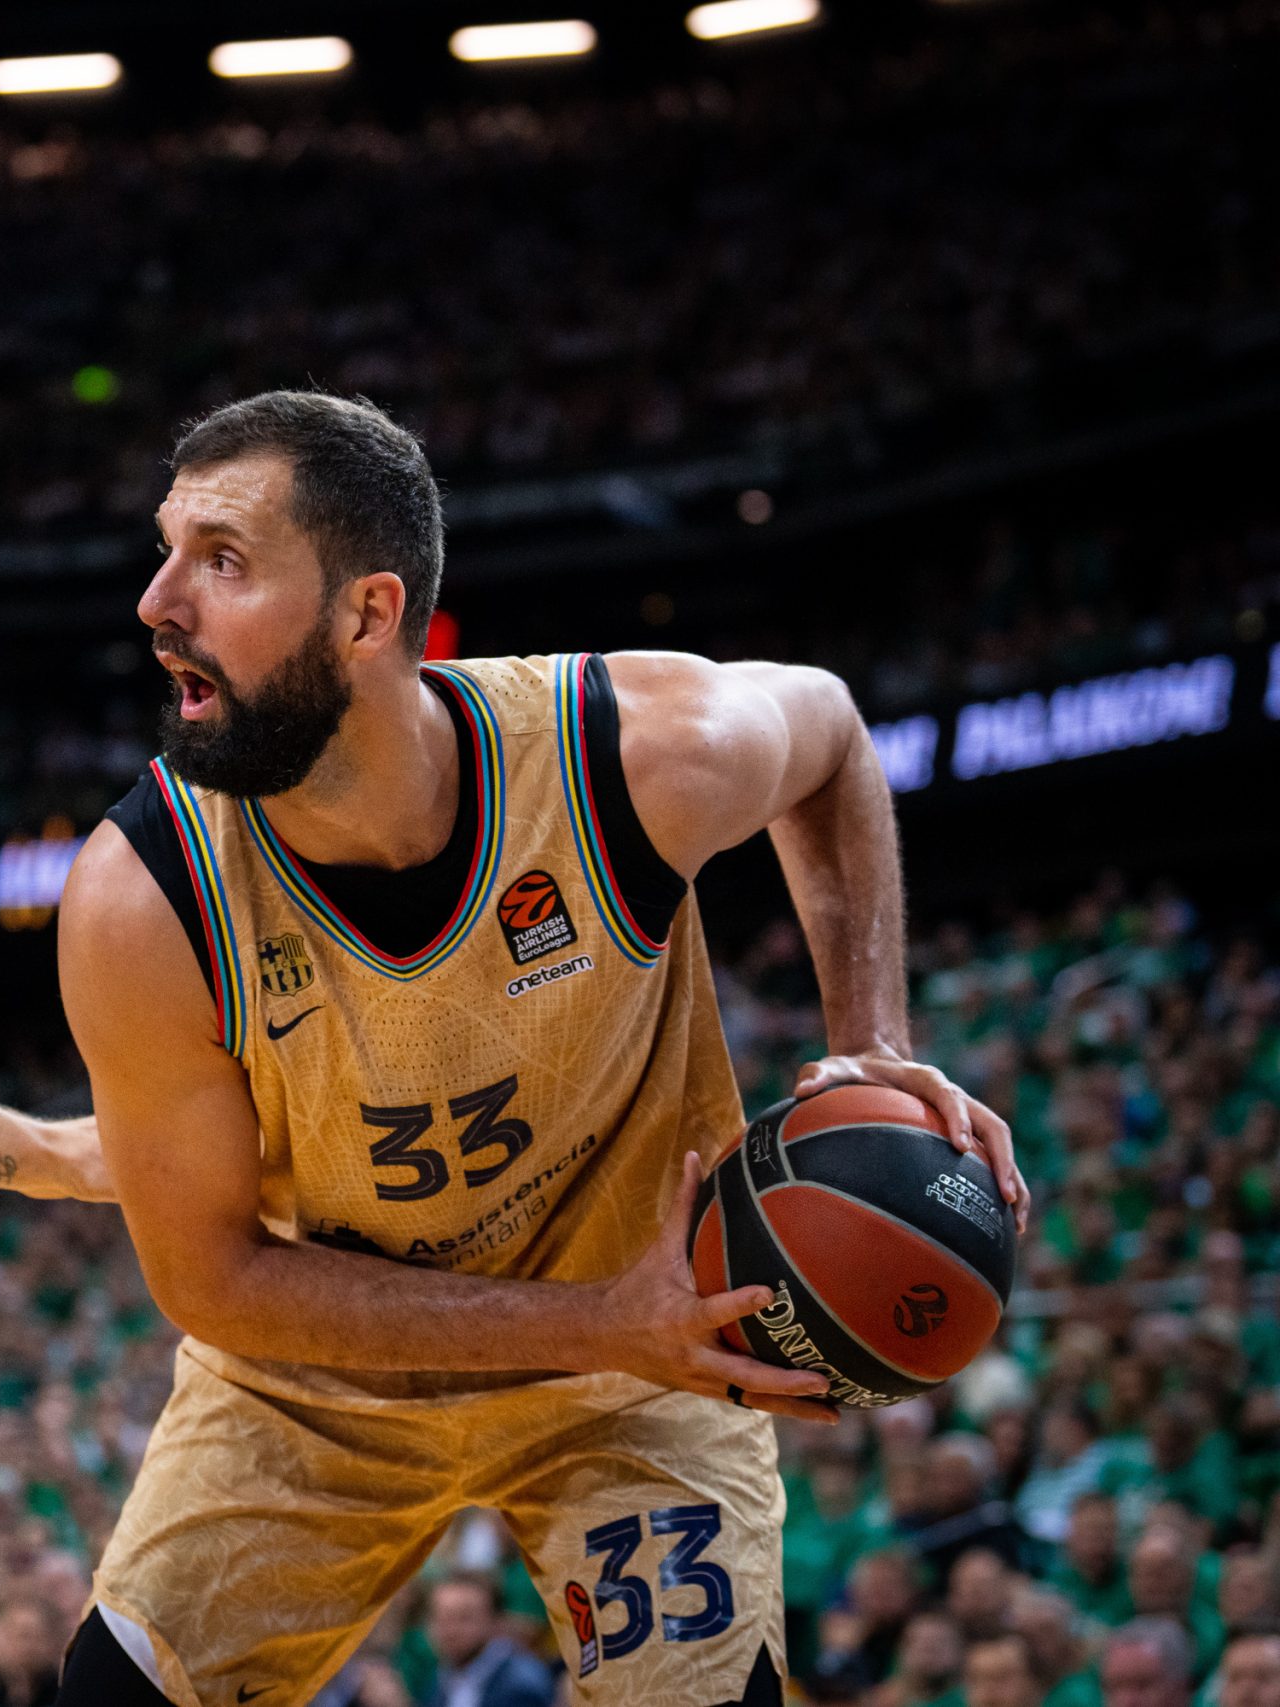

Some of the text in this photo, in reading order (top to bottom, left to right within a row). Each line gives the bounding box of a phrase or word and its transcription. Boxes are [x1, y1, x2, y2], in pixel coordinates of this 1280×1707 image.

[512, 914, 565, 944] TURKISH
[517, 923, 569, 953] AIRLINES
[518, 933, 572, 961] EuroLeague
[508, 955, 593, 996] oneteam
[359, 1073, 534, 1202] 33
[585, 1503, 735, 1661] 33
